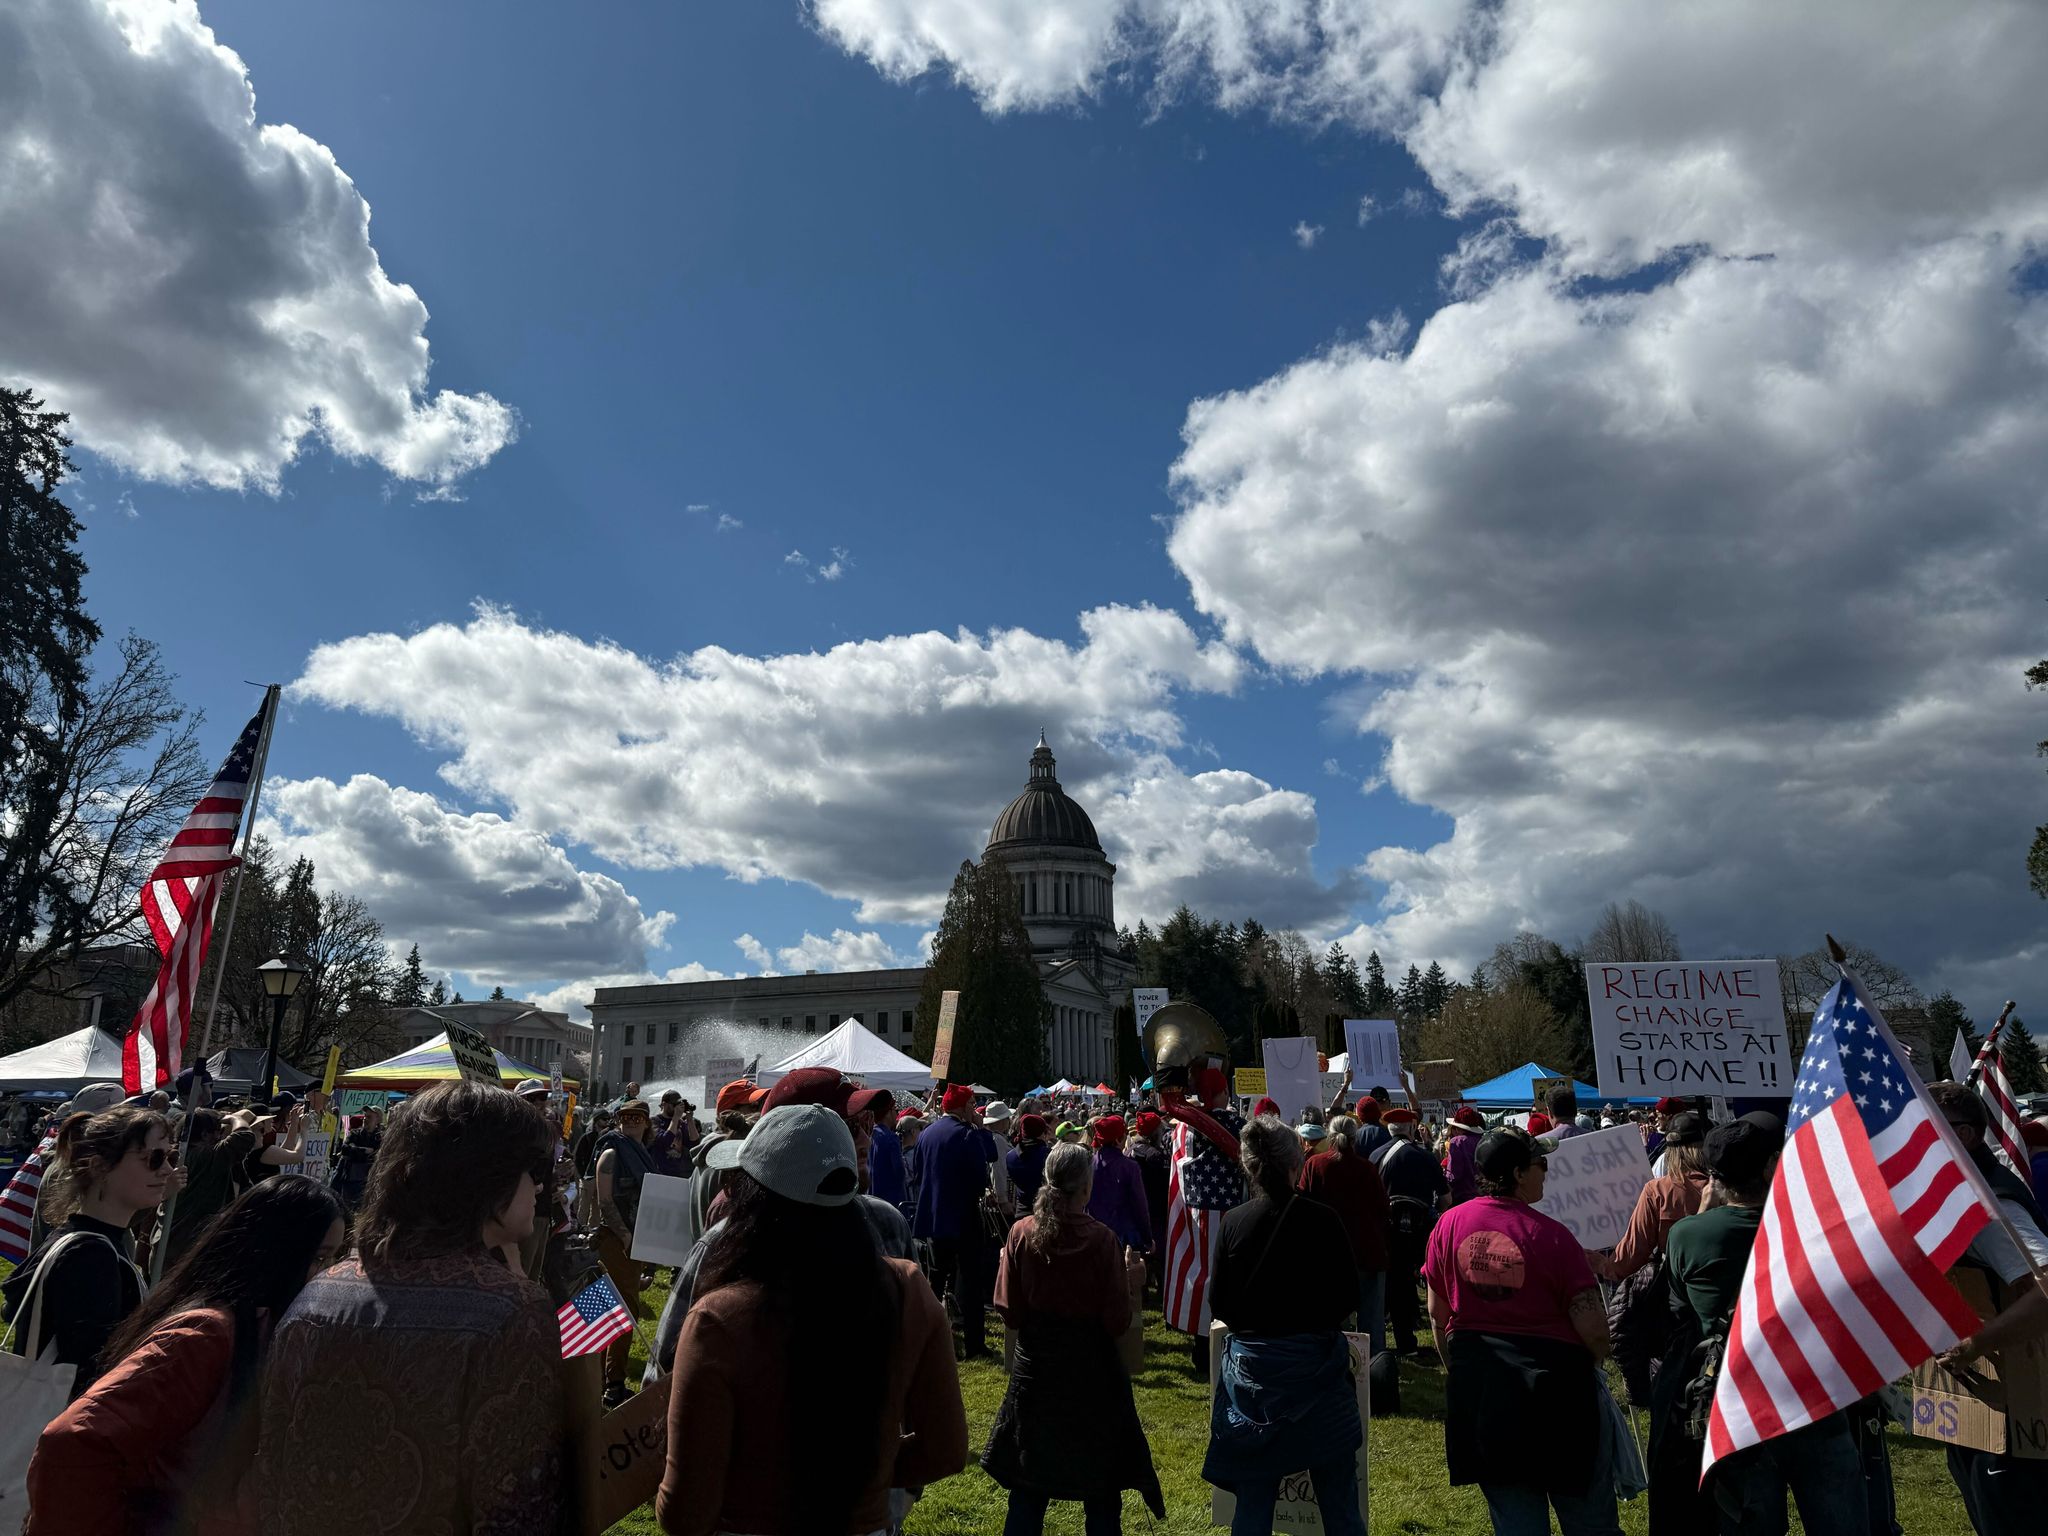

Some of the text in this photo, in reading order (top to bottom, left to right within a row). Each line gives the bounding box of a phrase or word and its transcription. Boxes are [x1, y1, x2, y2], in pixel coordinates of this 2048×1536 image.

[1601, 967, 1761, 1001] REGIME
[1615, 1005, 1755, 1029] CHANGE
[443, 1021, 493, 1058] NURSES
[1619, 1031, 1782, 1055] STARTS AT
[454, 1049, 500, 1081] AGAINST
[345, 1091, 387, 1107] MEDIA
[305, 1139, 330, 1157] ECRET
[1469, 1236, 1491, 1246] SEEDS
[1469, 1252, 1511, 1263] RESISTANCE
[1469, 1261, 1490, 1272] 2026
